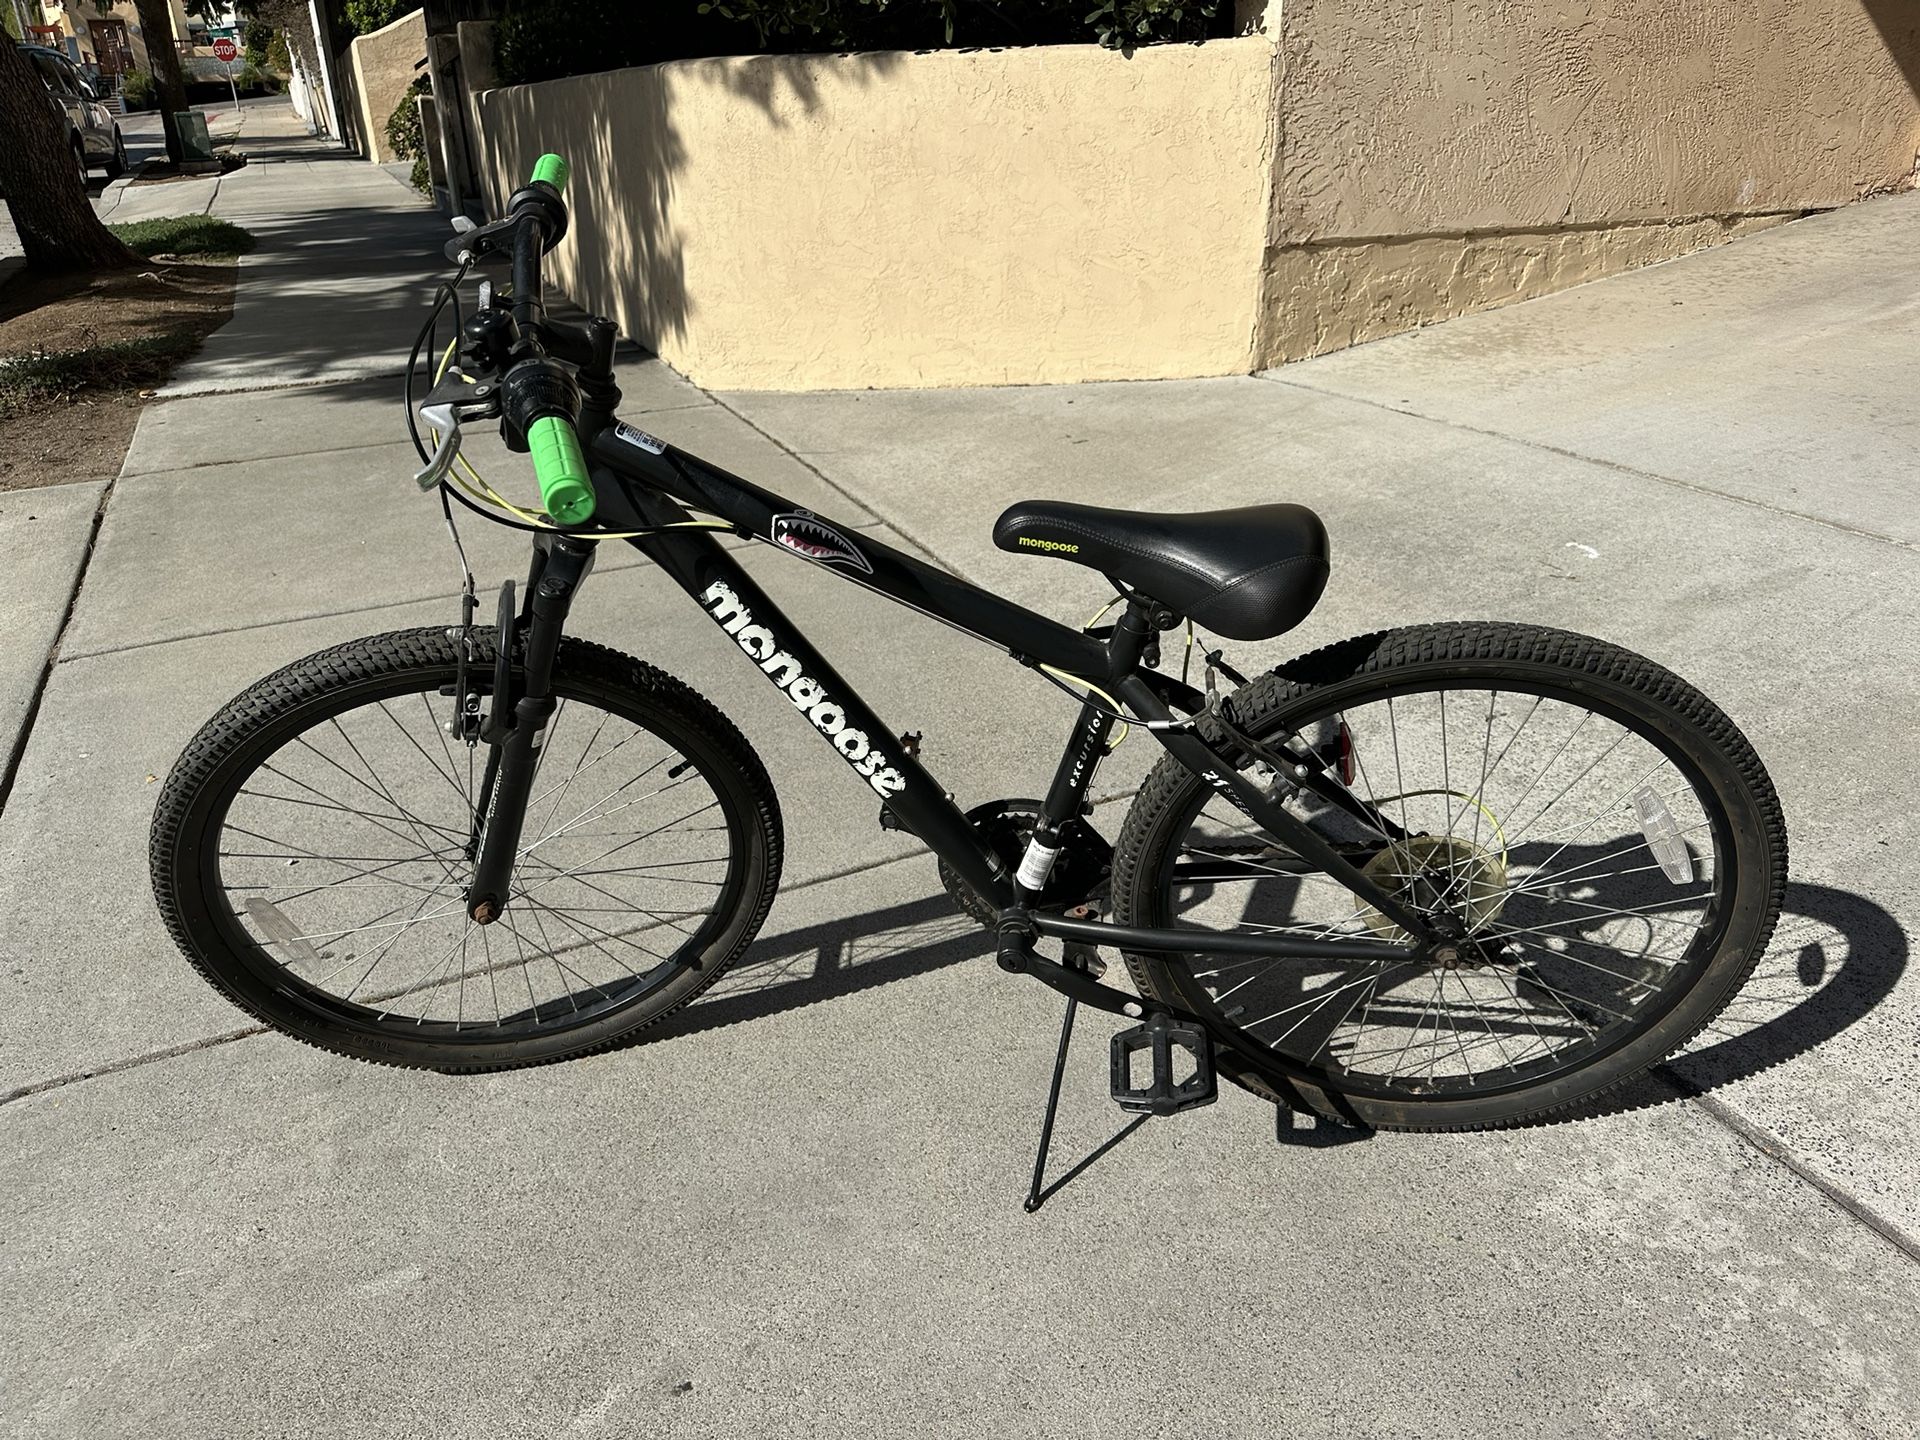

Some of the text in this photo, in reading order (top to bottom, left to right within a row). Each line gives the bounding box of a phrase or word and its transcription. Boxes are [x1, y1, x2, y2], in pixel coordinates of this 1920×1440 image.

[214, 45, 235, 55] STOP
[1018, 536, 1079, 553] mongoose
[700, 577, 906, 798] mongoose
